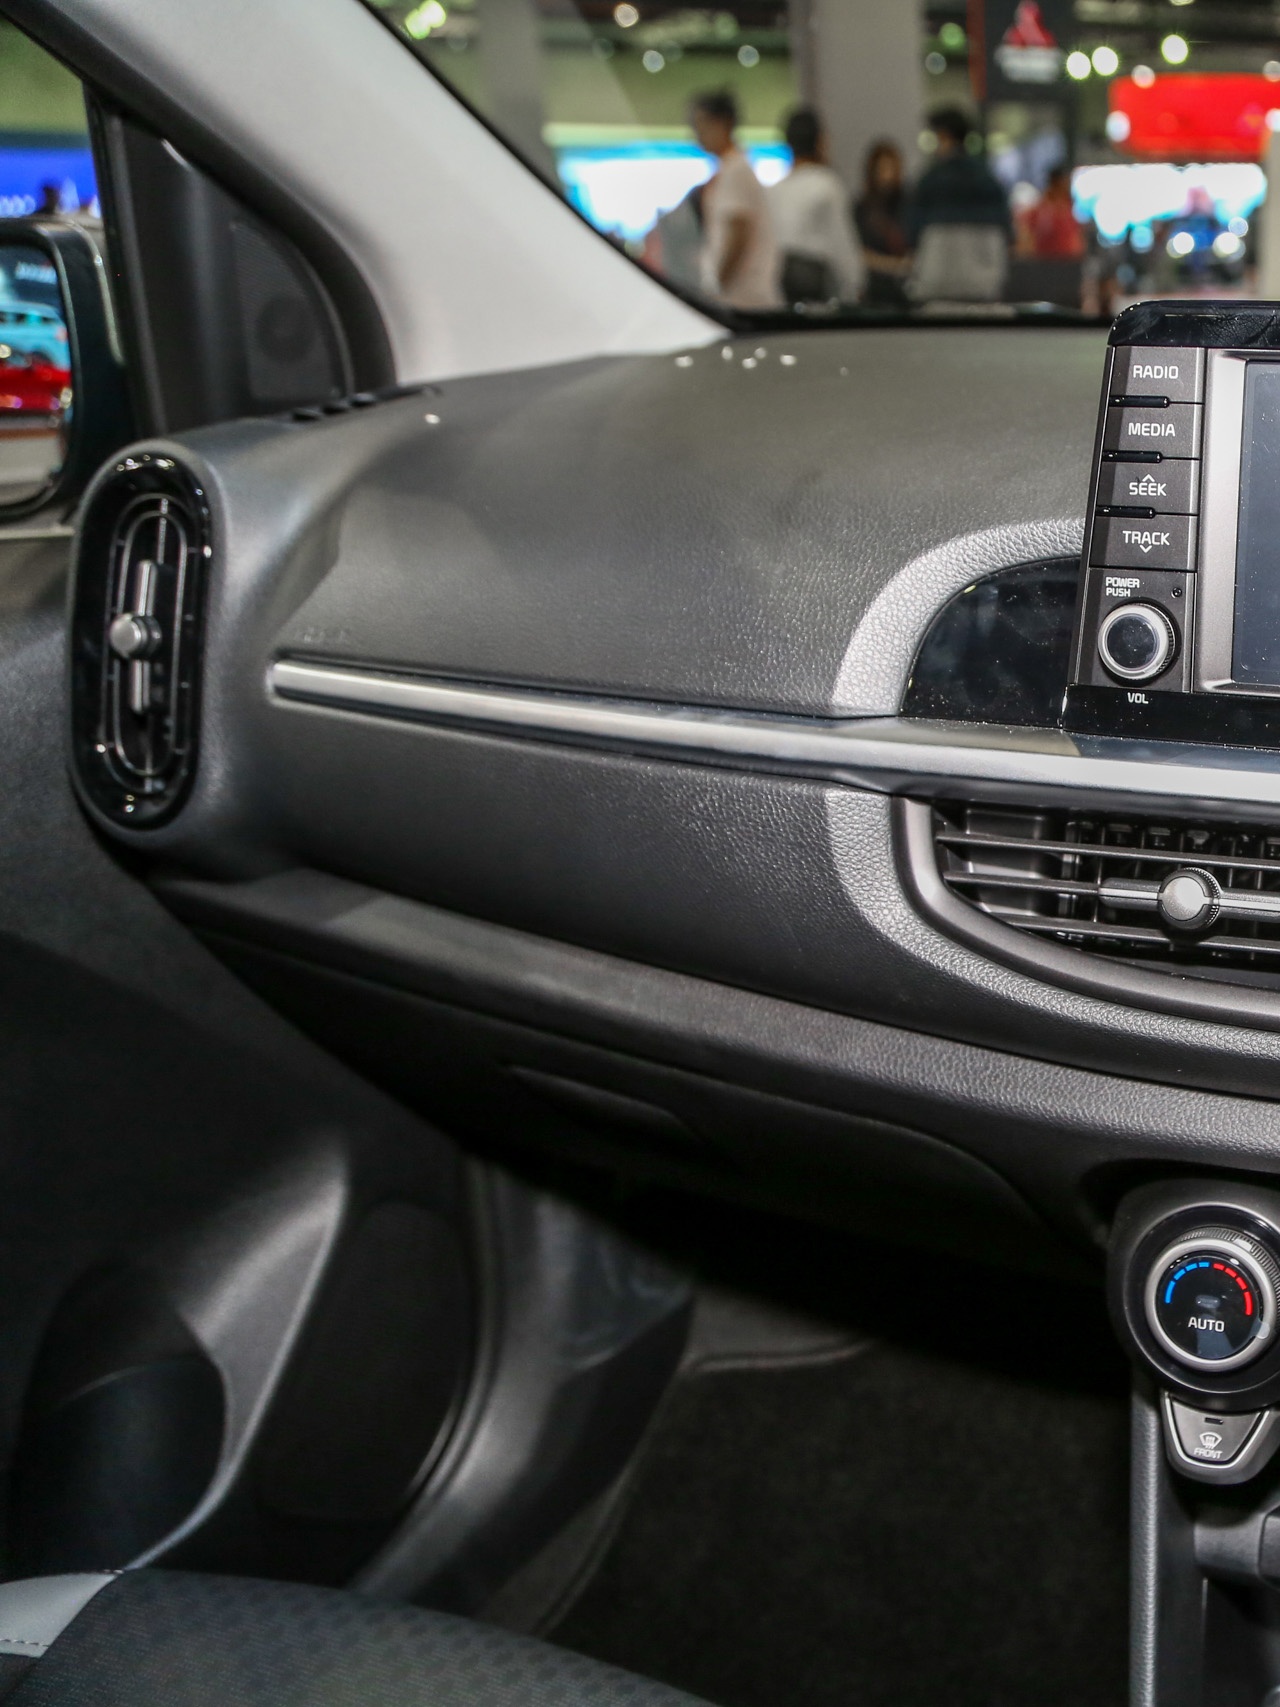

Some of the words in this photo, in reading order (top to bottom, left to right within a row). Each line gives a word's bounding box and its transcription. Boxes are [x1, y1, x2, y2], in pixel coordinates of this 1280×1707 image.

[1132, 365, 1179, 380] RADIO
[1127, 422, 1176, 437] MEDIA
[1128, 481, 1167, 497] SEEK
[1122, 530, 1170, 546] TRACK
[1105, 576, 1140, 589] POWER
[1105, 587, 1131, 598] PUSH
[1127, 692, 1149, 704] VOL
[1188, 1317, 1225, 1333] AUTO
[1193, 1447, 1223, 1459] FRONT
